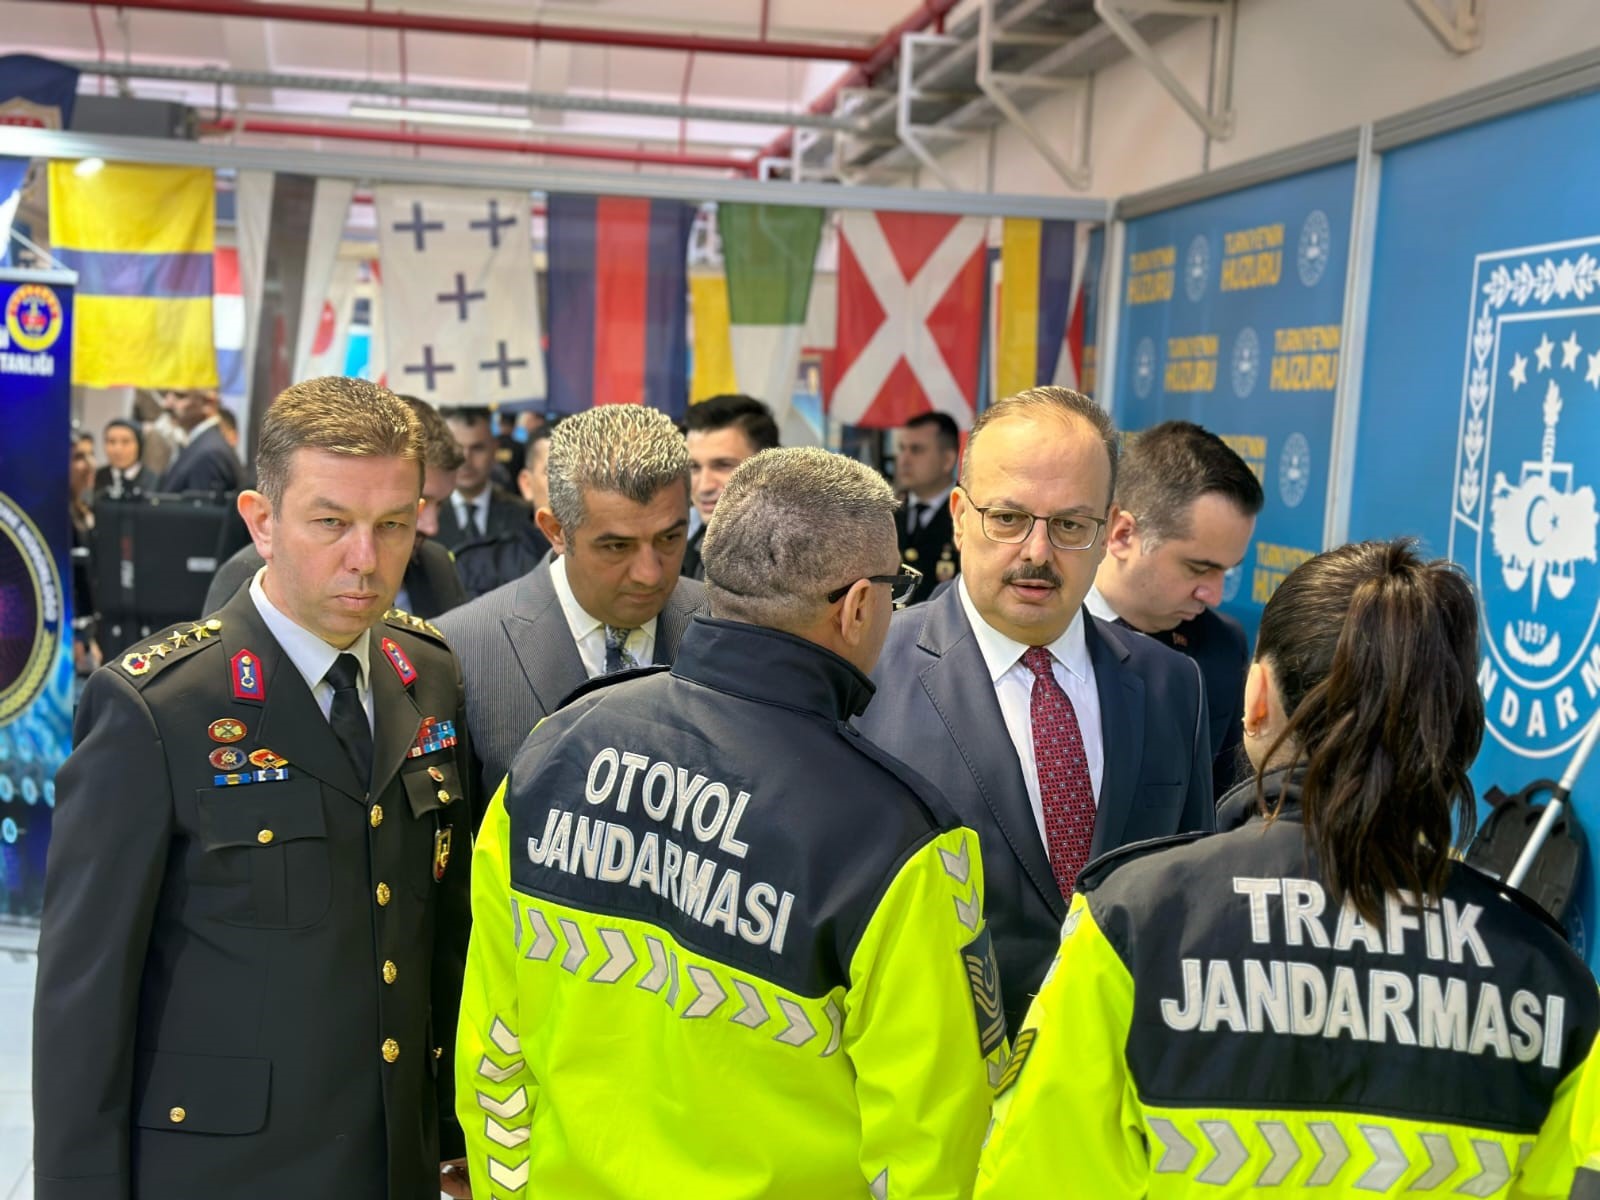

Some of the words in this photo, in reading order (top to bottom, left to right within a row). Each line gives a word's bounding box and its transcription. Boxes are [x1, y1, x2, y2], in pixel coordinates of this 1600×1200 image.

[1269, 353, 1339, 391] HUZURU
[1517, 619, 1548, 645] 1839
[585, 747, 752, 859] OTOYOL
[527, 809, 795, 955] JANDARMASI
[1160, 958, 1566, 1069] JANDARMASI
